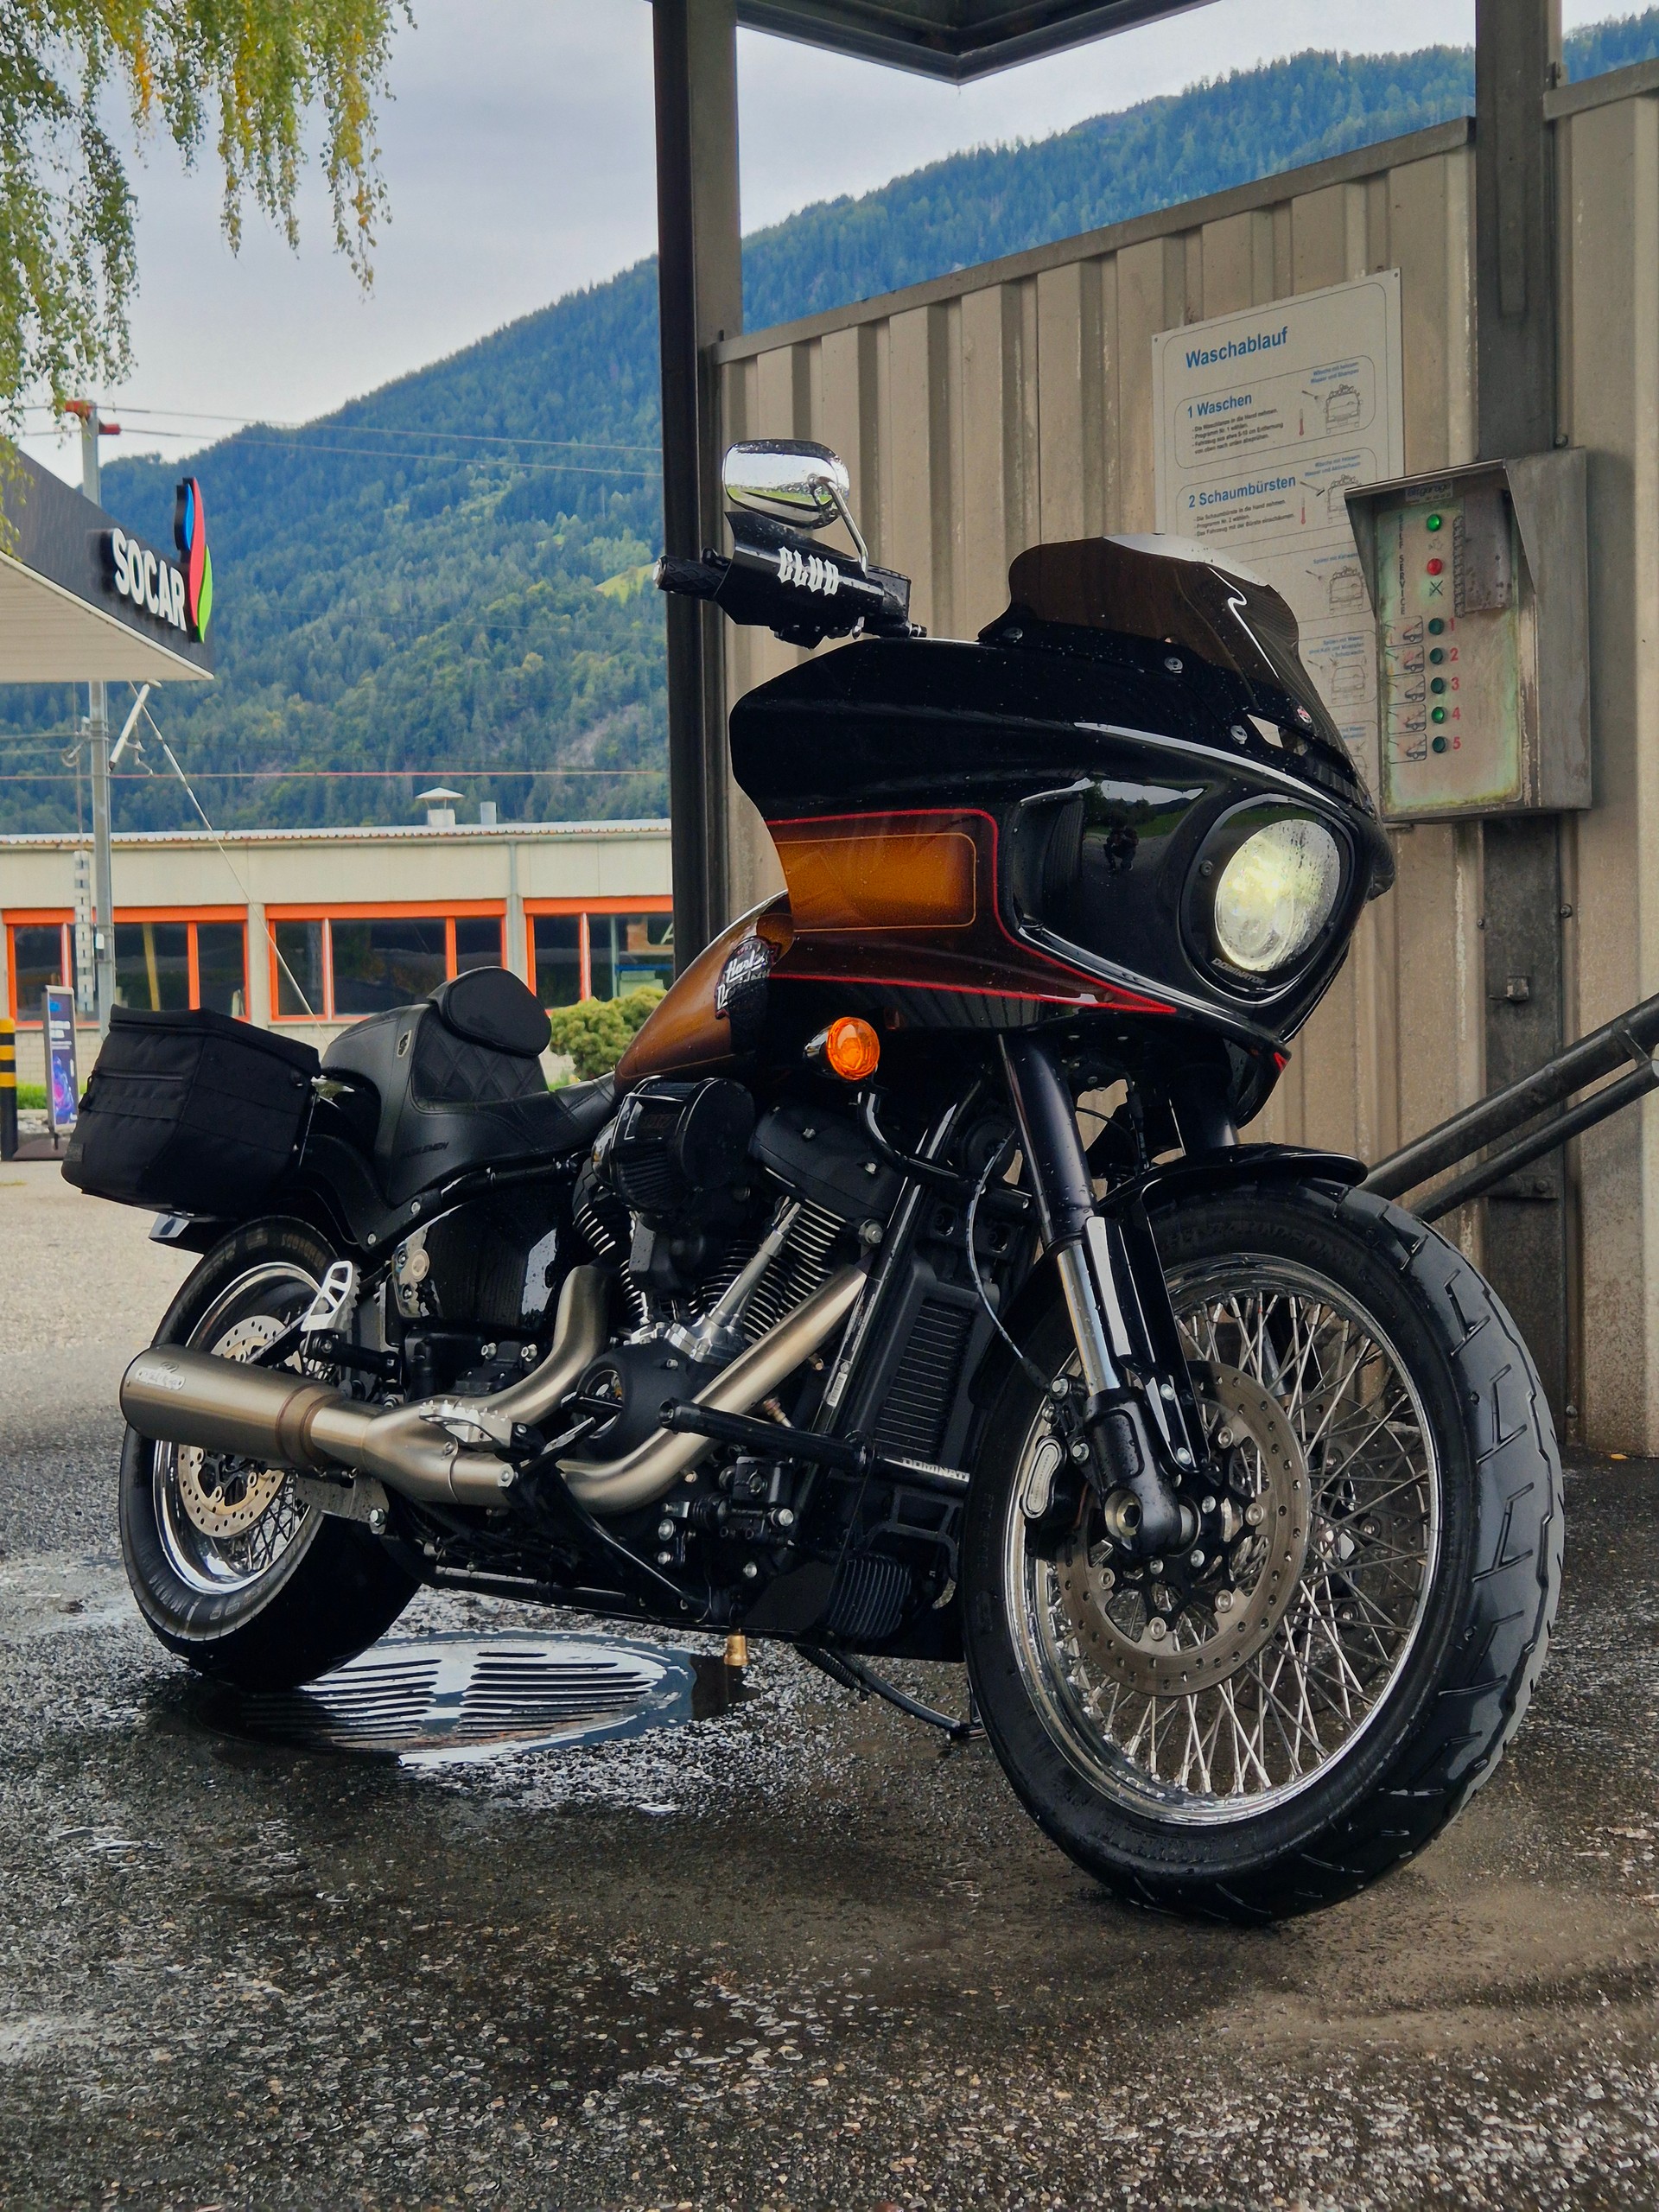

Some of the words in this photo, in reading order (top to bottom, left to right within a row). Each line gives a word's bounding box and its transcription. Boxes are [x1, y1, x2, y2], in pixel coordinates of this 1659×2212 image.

[1185, 326, 1288, 368] Waschablauf
[1187, 405, 1192, 418] 1
[1197, 394, 1252, 416] Waschen
[1189, 494, 1195, 508] 2
[1199, 476, 1296, 505] Schaumbürsten
[112, 527, 187, 632] SOCAR
[1448, 617, 1455, 631] 1
[1450, 647, 1459, 662] 2
[1451, 677, 1459, 691] 3
[1452, 707, 1460, 720] 4
[1453, 736, 1461, 750] 5
